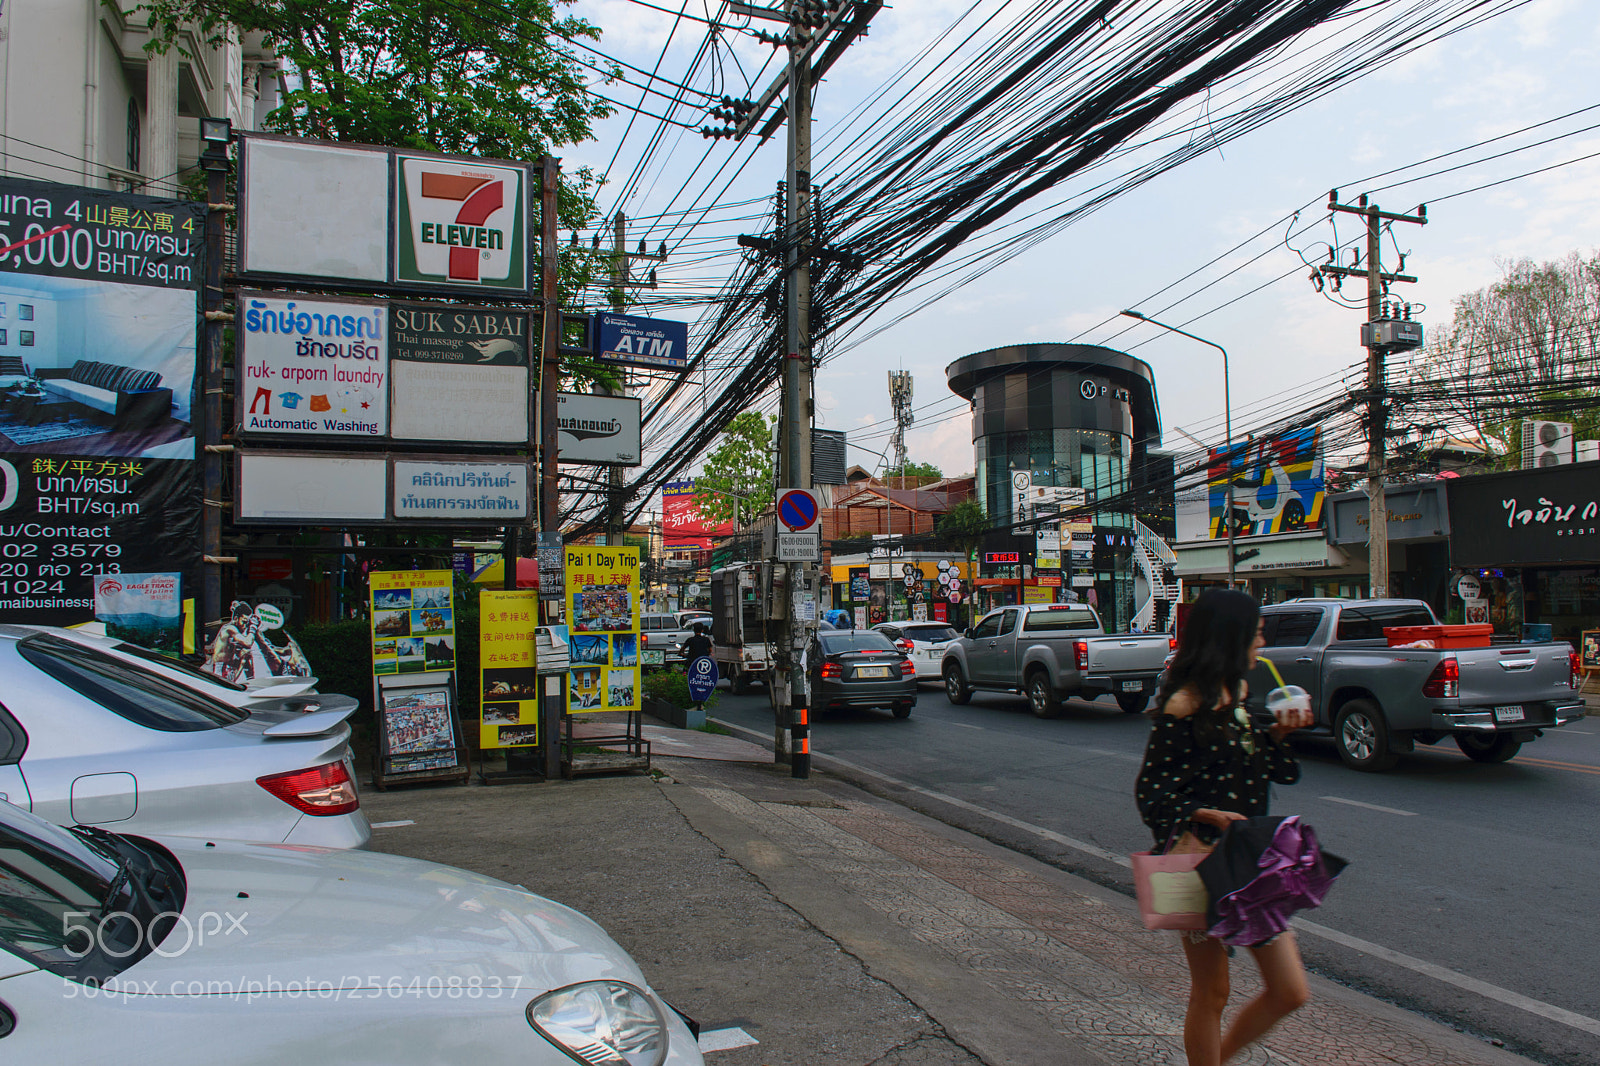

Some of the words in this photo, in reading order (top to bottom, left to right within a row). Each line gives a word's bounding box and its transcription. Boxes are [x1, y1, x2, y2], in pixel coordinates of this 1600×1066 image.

[64, 200, 82, 222] 4
[86, 204, 174, 233] 山景公寓
[181, 217, 195, 234] 4
[97, 252, 191, 284] BHT/sq.m
[245, 300, 383, 340] รักษ์อาภรณ์
[395, 309, 445, 333] SUK
[453, 314, 523, 336] SABAI
[295, 336, 379, 361] ซักอบรีด
[395, 332, 418, 343] Thai
[422, 337, 464, 349] massage
[614, 335, 674, 357] ATM
[396, 348, 412, 358] Tel.
[281, 367, 328, 384] arporn
[333, 363, 384, 389] laundry
[249, 417, 318, 431] Automatic
[323, 419, 378, 434] Washing
[37, 497, 140, 517] BHT/sq.m
[1556, 527, 1597, 536] esan
[51, 543, 122, 558] 3579
[39, 558, 71, 577] ต่อ
[80, 562, 121, 575] 213
[568, 553, 583, 566] Pai
[587, 553, 592, 566] 1
[597, 553, 615, 569] Day
[618, 553, 637, 569] Trip
[573, 573, 596, 585] 拜县
[609, 573, 632, 585] 天游
